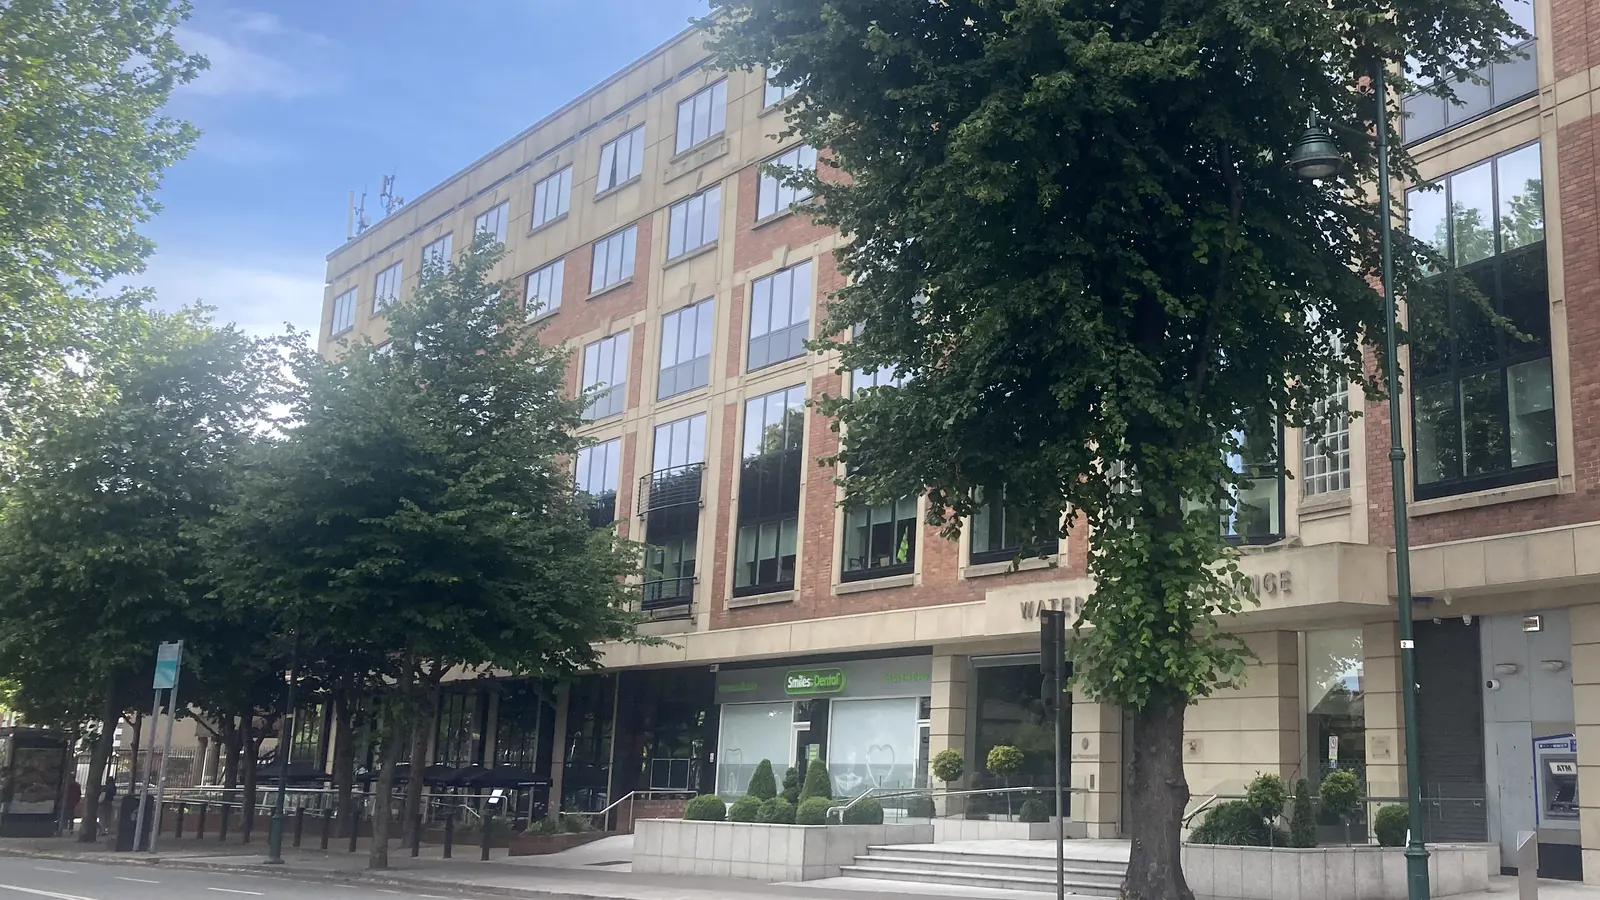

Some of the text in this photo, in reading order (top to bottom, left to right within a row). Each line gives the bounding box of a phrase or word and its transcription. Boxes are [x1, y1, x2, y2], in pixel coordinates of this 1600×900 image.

[787, 672, 840, 689] Smiles Dental
[1556, 764, 1573, 772] ATM
